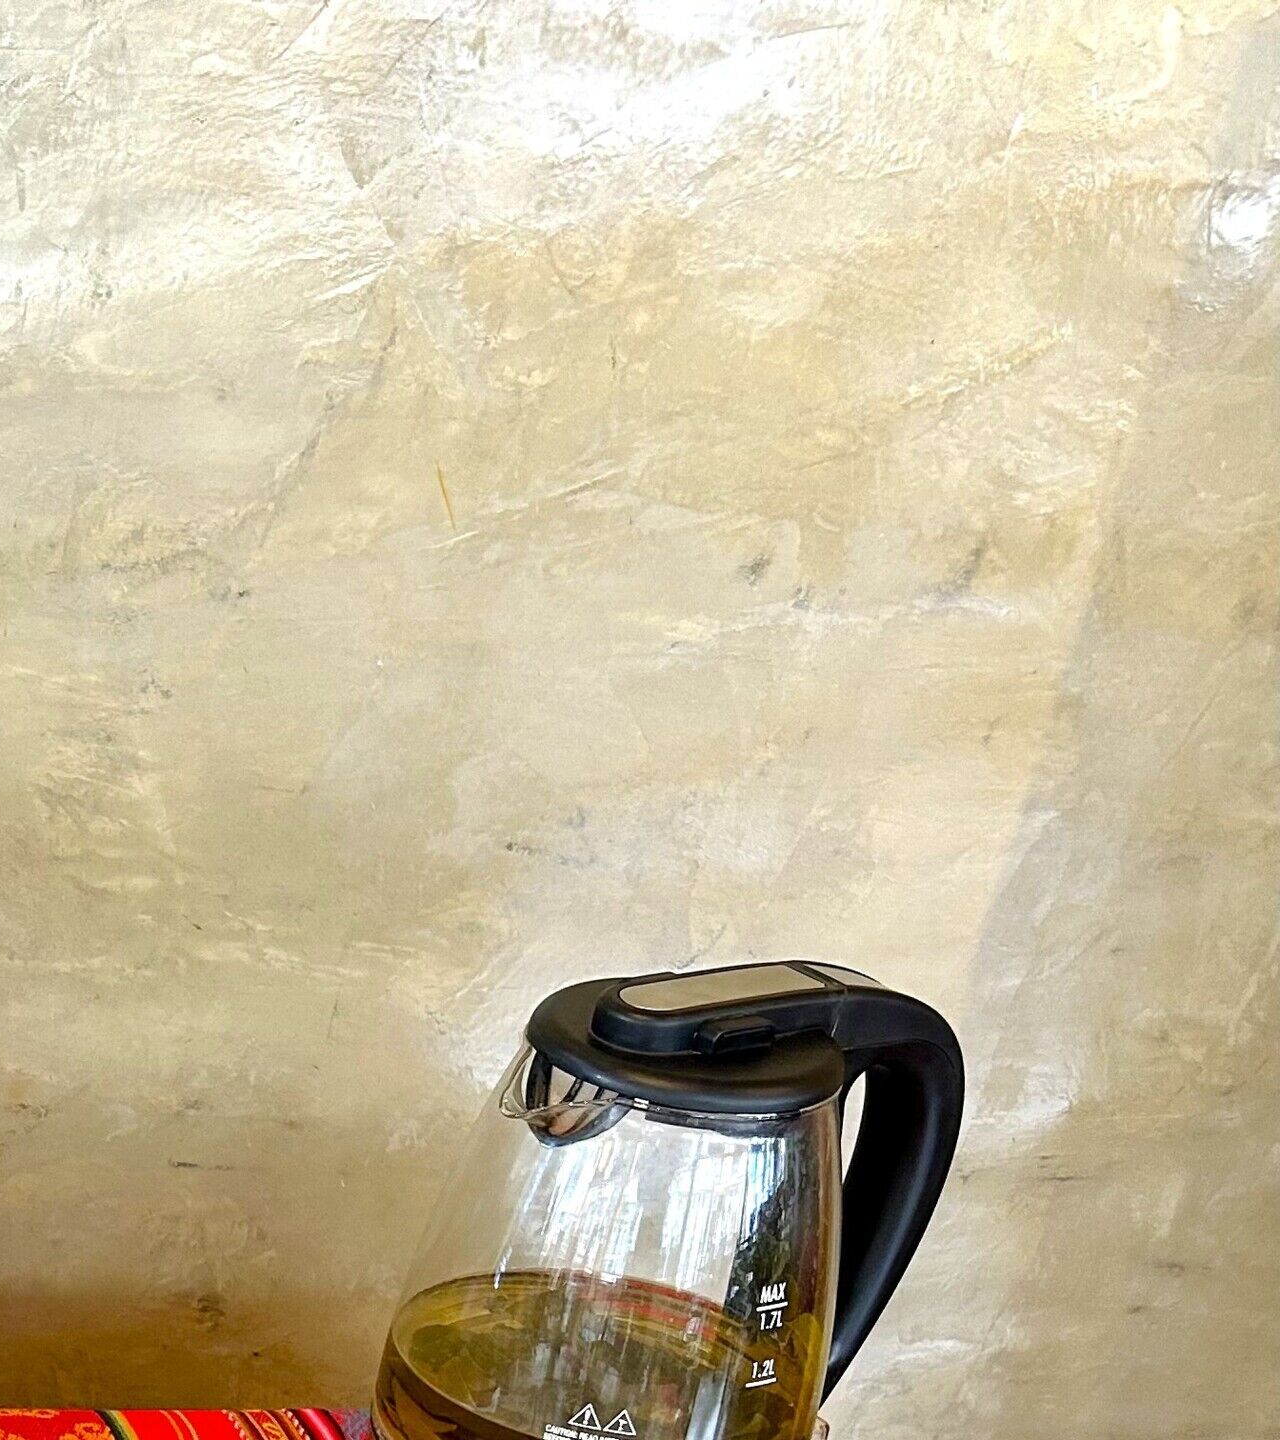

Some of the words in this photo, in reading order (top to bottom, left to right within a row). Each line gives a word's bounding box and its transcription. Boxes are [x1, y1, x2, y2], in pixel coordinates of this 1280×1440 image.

[759, 1282, 787, 1304] MAX
[759, 1310, 783, 1331] 1.7L
[751, 1358, 775, 1379] 1.2L
